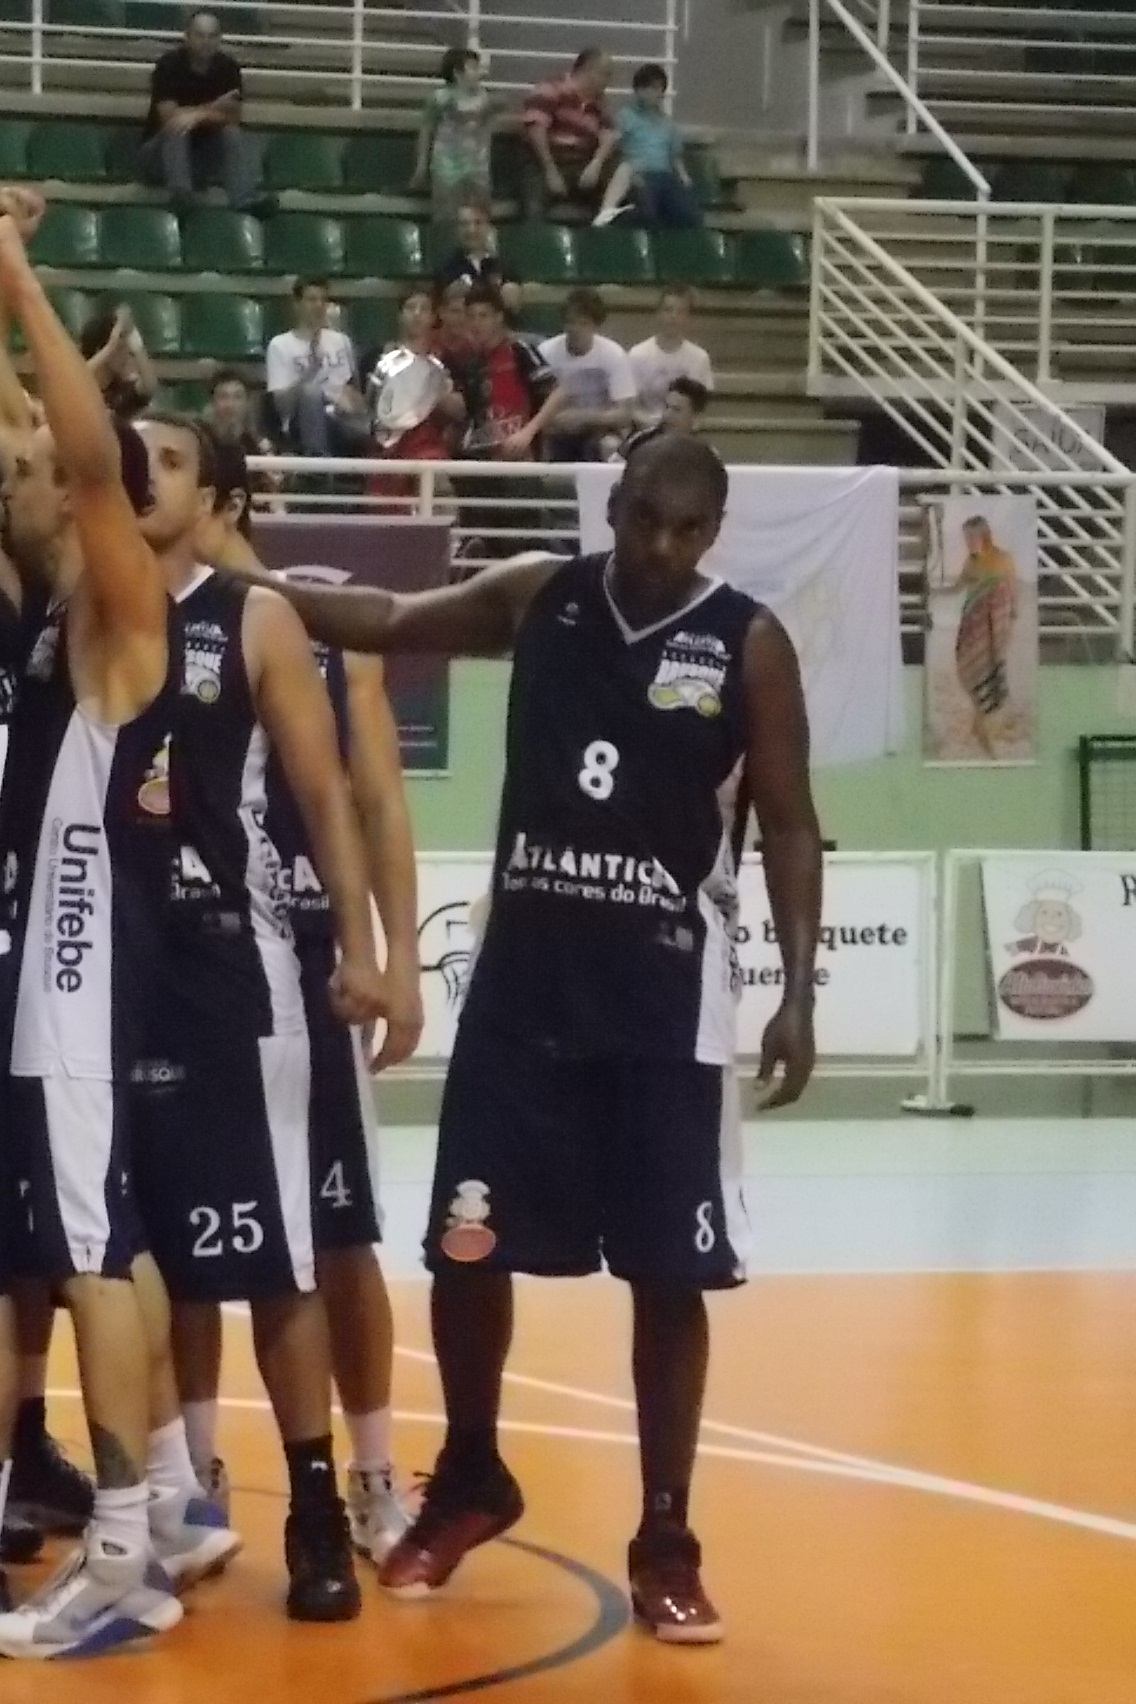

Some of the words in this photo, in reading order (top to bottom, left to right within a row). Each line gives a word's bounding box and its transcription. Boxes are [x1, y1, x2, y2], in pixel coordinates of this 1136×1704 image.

[578, 739, 619, 800] 8
[56, 823, 102, 993] Unifebe
[611, 884, 635, 904] do
[320, 1160, 353, 1209] 4
[189, 1200, 264, 1258] 25
[695, 1200, 716, 1254] 8
